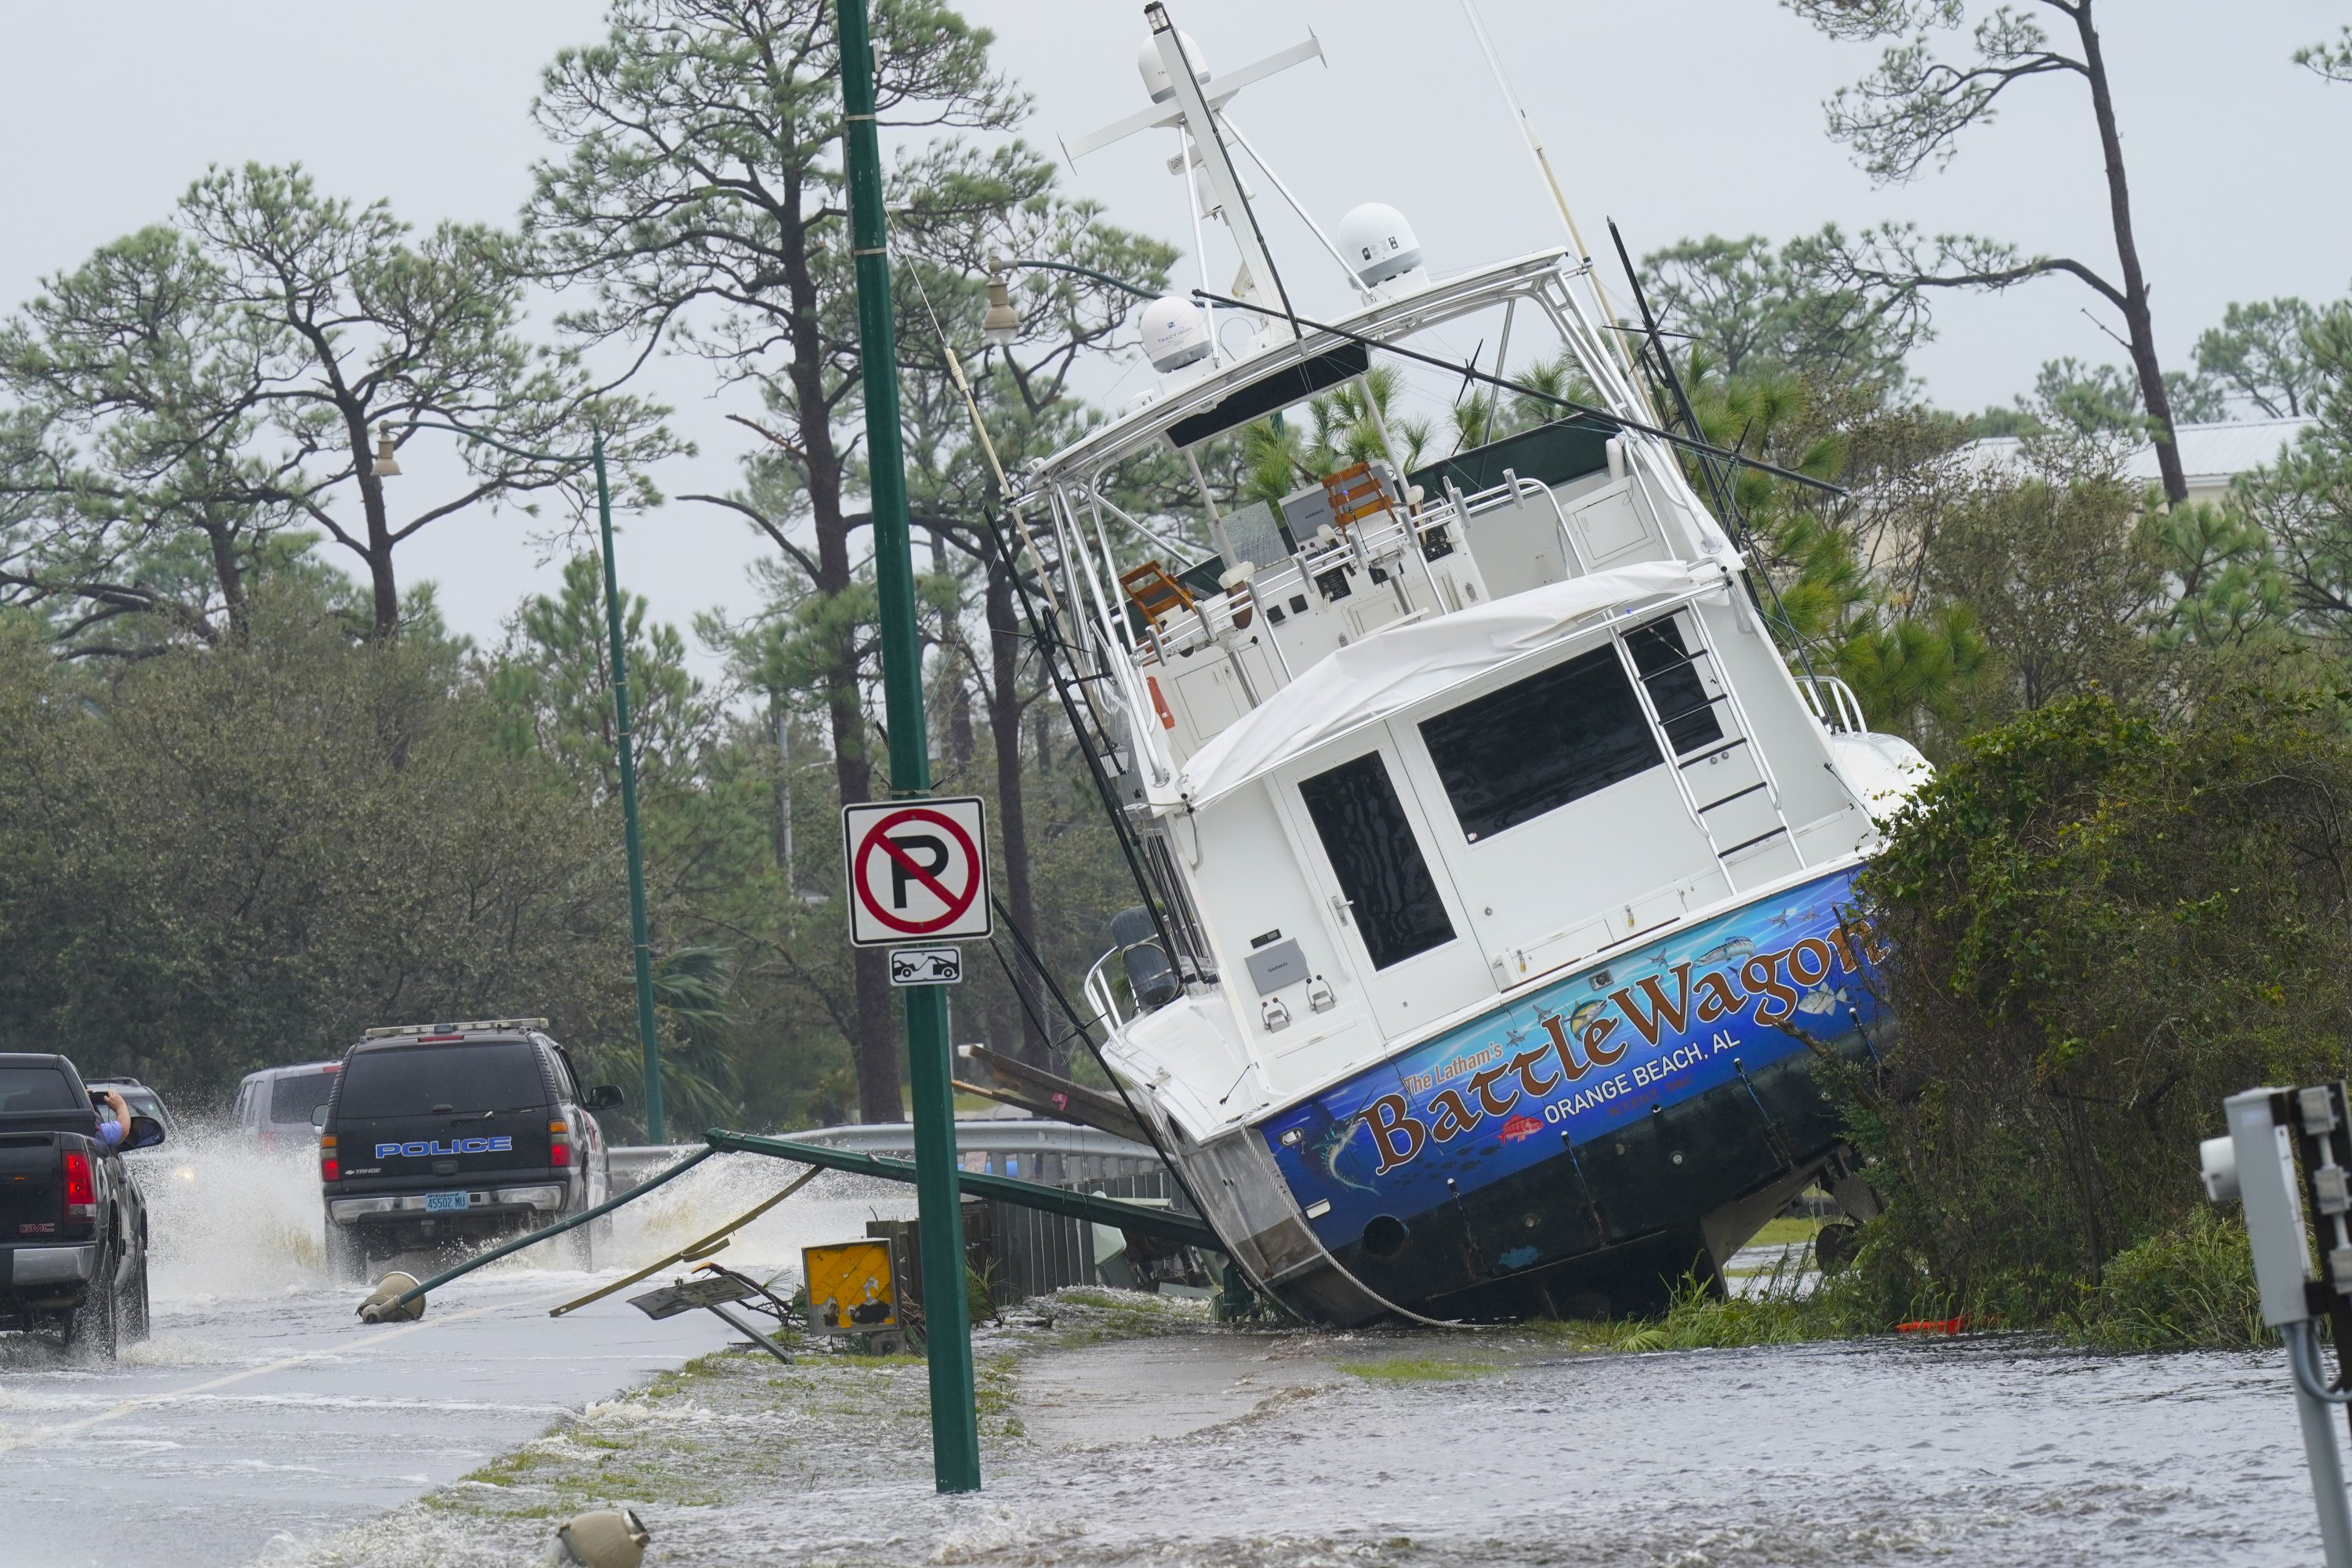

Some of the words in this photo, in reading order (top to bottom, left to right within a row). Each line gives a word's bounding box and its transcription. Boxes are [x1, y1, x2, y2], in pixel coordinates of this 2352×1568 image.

[1305, 508, 1325, 519] GARMIN
[1268, 961, 1288, 973] GARMIN
[1404, 1074, 1432, 1095] The
[1435, 1041, 1504, 1084] Latham's
[1544, 1073, 1632, 1123] ORANGE
[1632, 1042, 1708, 1087] BEACH,
[1712, 1029, 1741, 1054] AL
[376, 1136, 512, 1159] POLICE
[428, 1197, 452, 1208] 45502
[455, 1196, 466, 1207] MU
[20, 1223, 55, 1233] GMC
